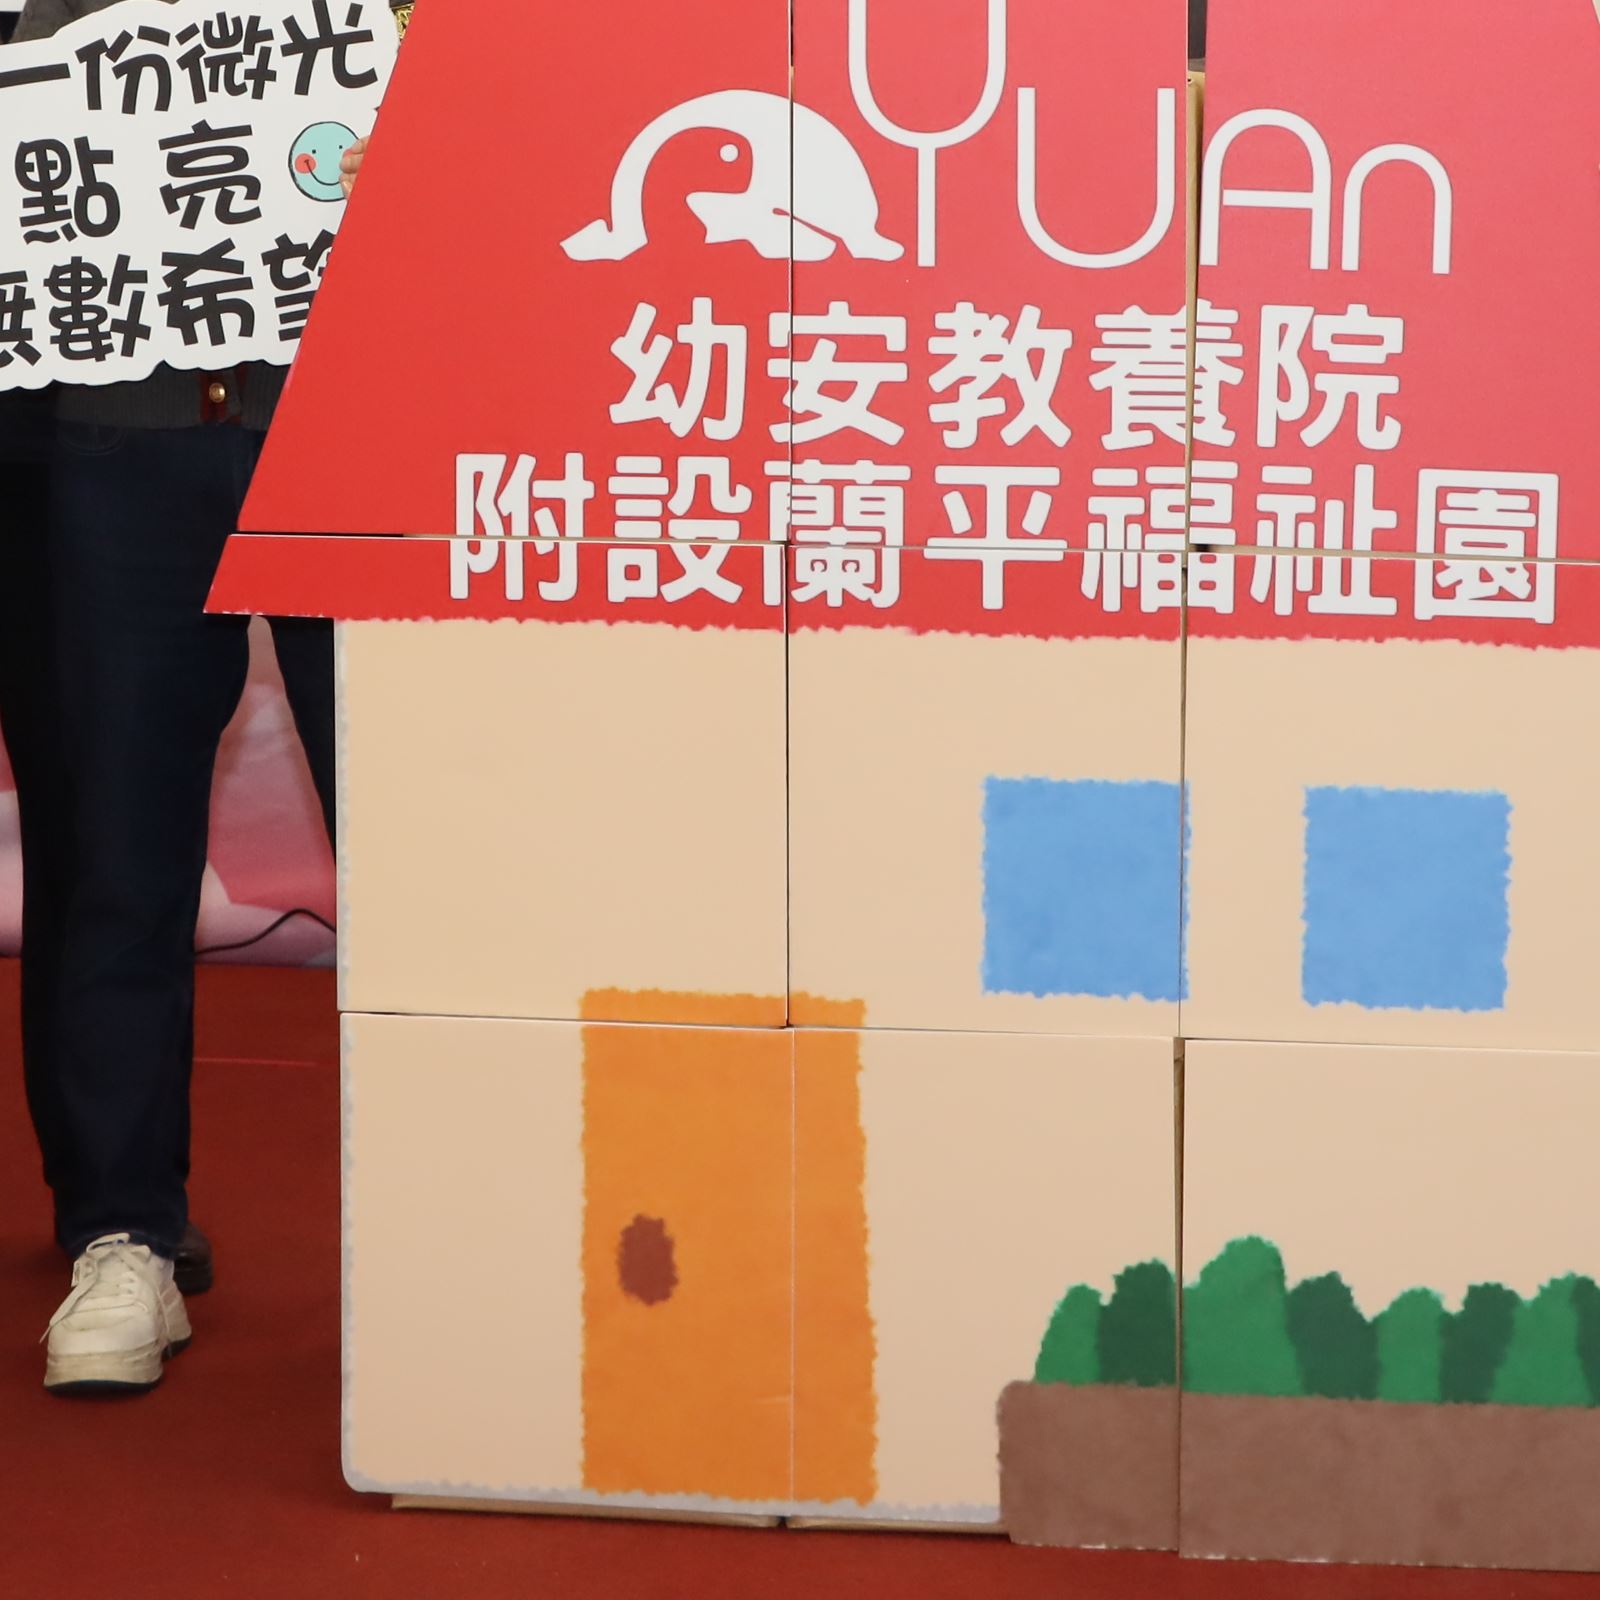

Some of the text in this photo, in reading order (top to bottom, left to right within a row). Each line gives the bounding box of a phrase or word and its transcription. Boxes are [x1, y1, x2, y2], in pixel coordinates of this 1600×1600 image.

[15, 119, 262, 245] 點亮
[609, 296, 1403, 452] 幼安教養院
[450, 452, 1560, 625] 附設蘭平福祉園
